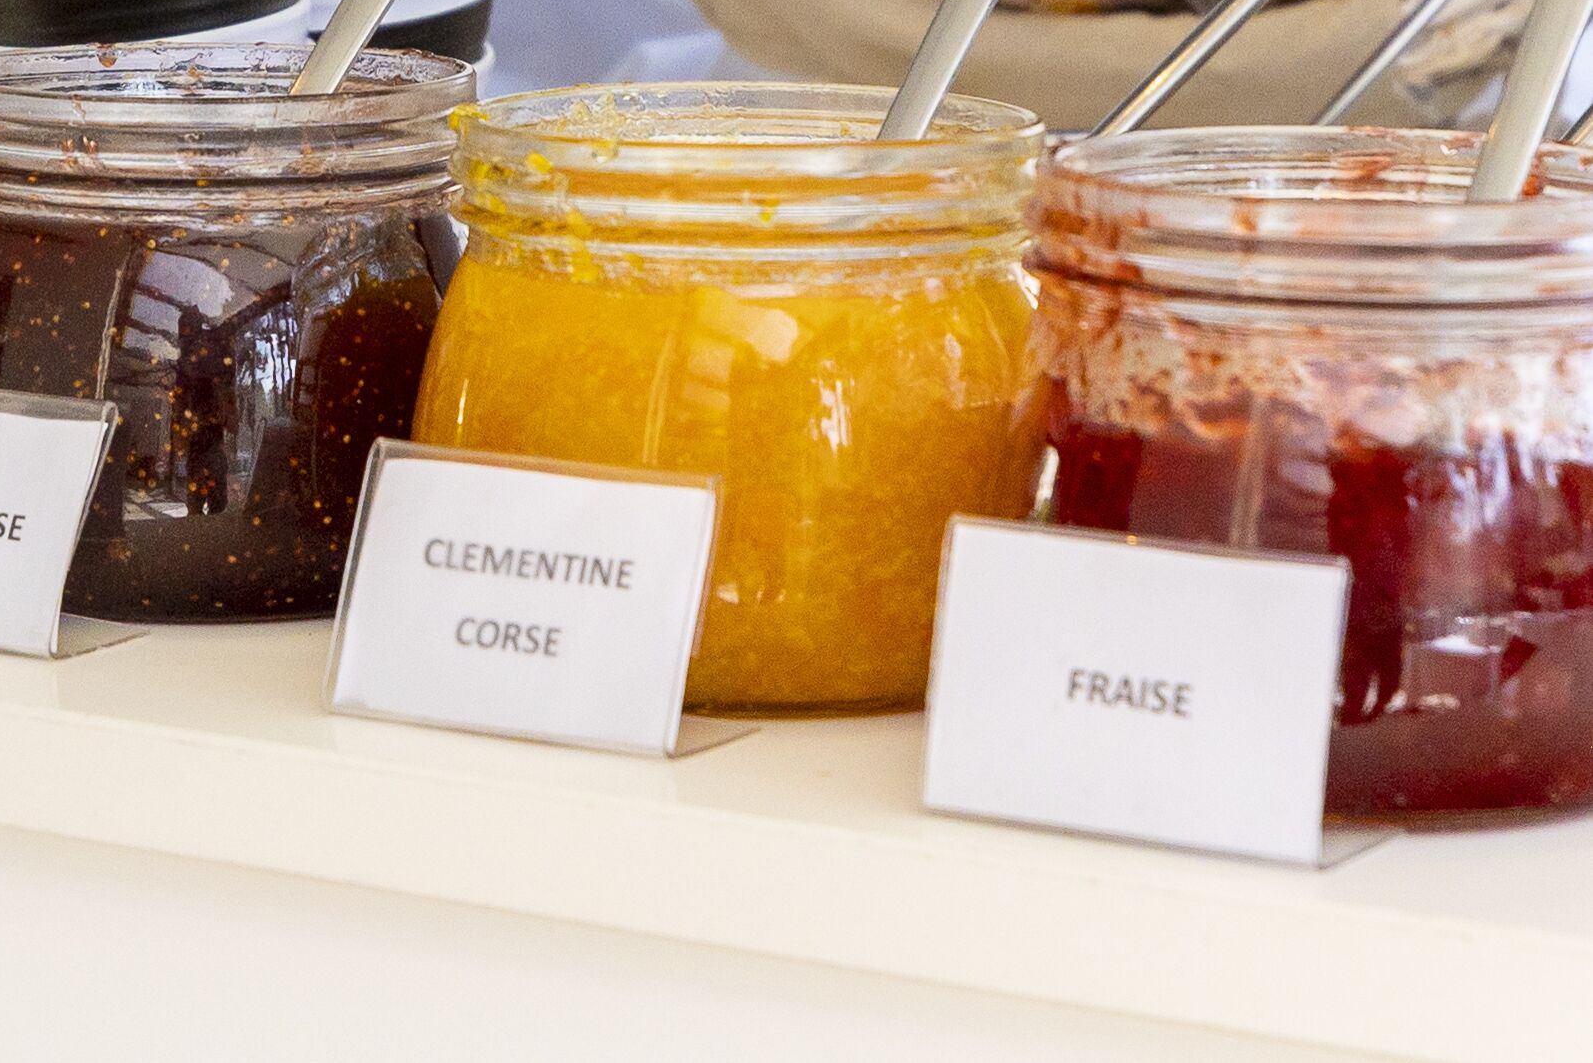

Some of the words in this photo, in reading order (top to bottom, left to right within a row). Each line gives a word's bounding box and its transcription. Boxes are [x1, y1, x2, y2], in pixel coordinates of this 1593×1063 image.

[424, 538, 635, 590] CLEMENTINE
[455, 617, 563, 657] CORSE
[1067, 668, 1192, 717] FRAISE
